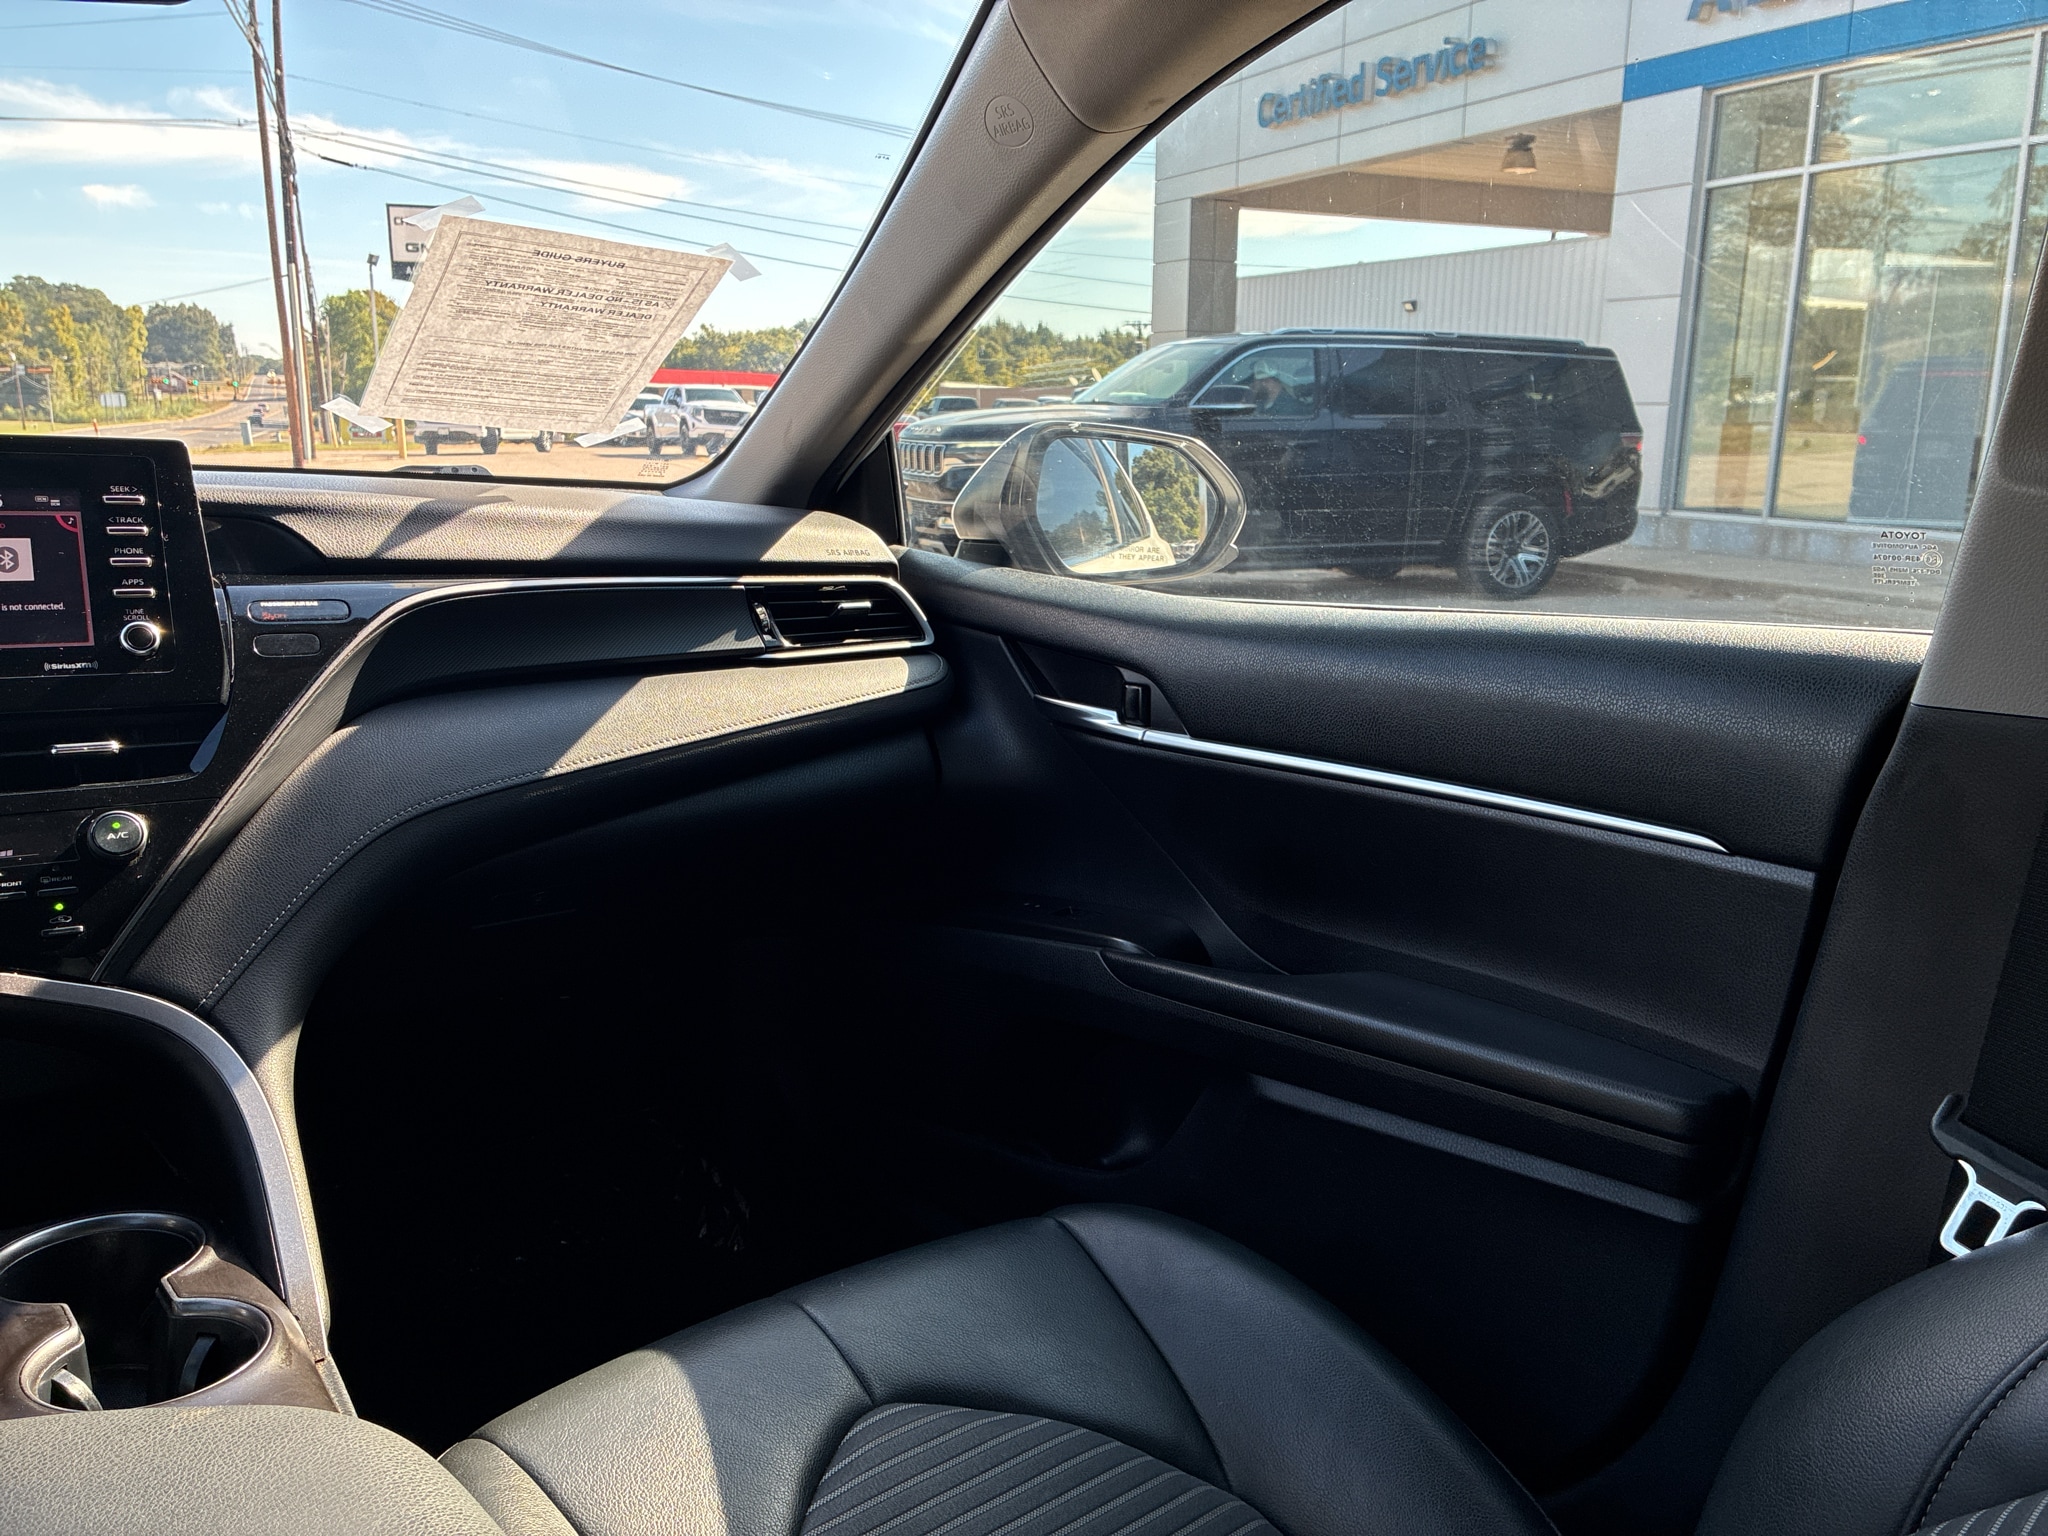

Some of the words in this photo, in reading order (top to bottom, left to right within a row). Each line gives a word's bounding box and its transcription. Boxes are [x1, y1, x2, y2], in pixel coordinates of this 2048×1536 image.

[1258, 62, 1370, 129] Certified
[1376, 37, 1490, 97] Service
[994, 102, 1015, 120] SRS
[992, 117, 1031, 139] AIRBAG
[109, 485, 130, 493] SEEK
[115, 516, 144, 524] TRACK
[114, 547, 144, 555] PHONE
[843, 549, 871, 557] AIRBAG
[1147, 546, 1161, 554] ARE
[1138, 554, 1165, 562] APPEAR
[121, 578, 145, 586] APPS
[1, 603, 8, 611] is
[9, 603, 23, 611] not
[24, 602, 66, 611] connected.
[107, 831, 129, 840] A/C
